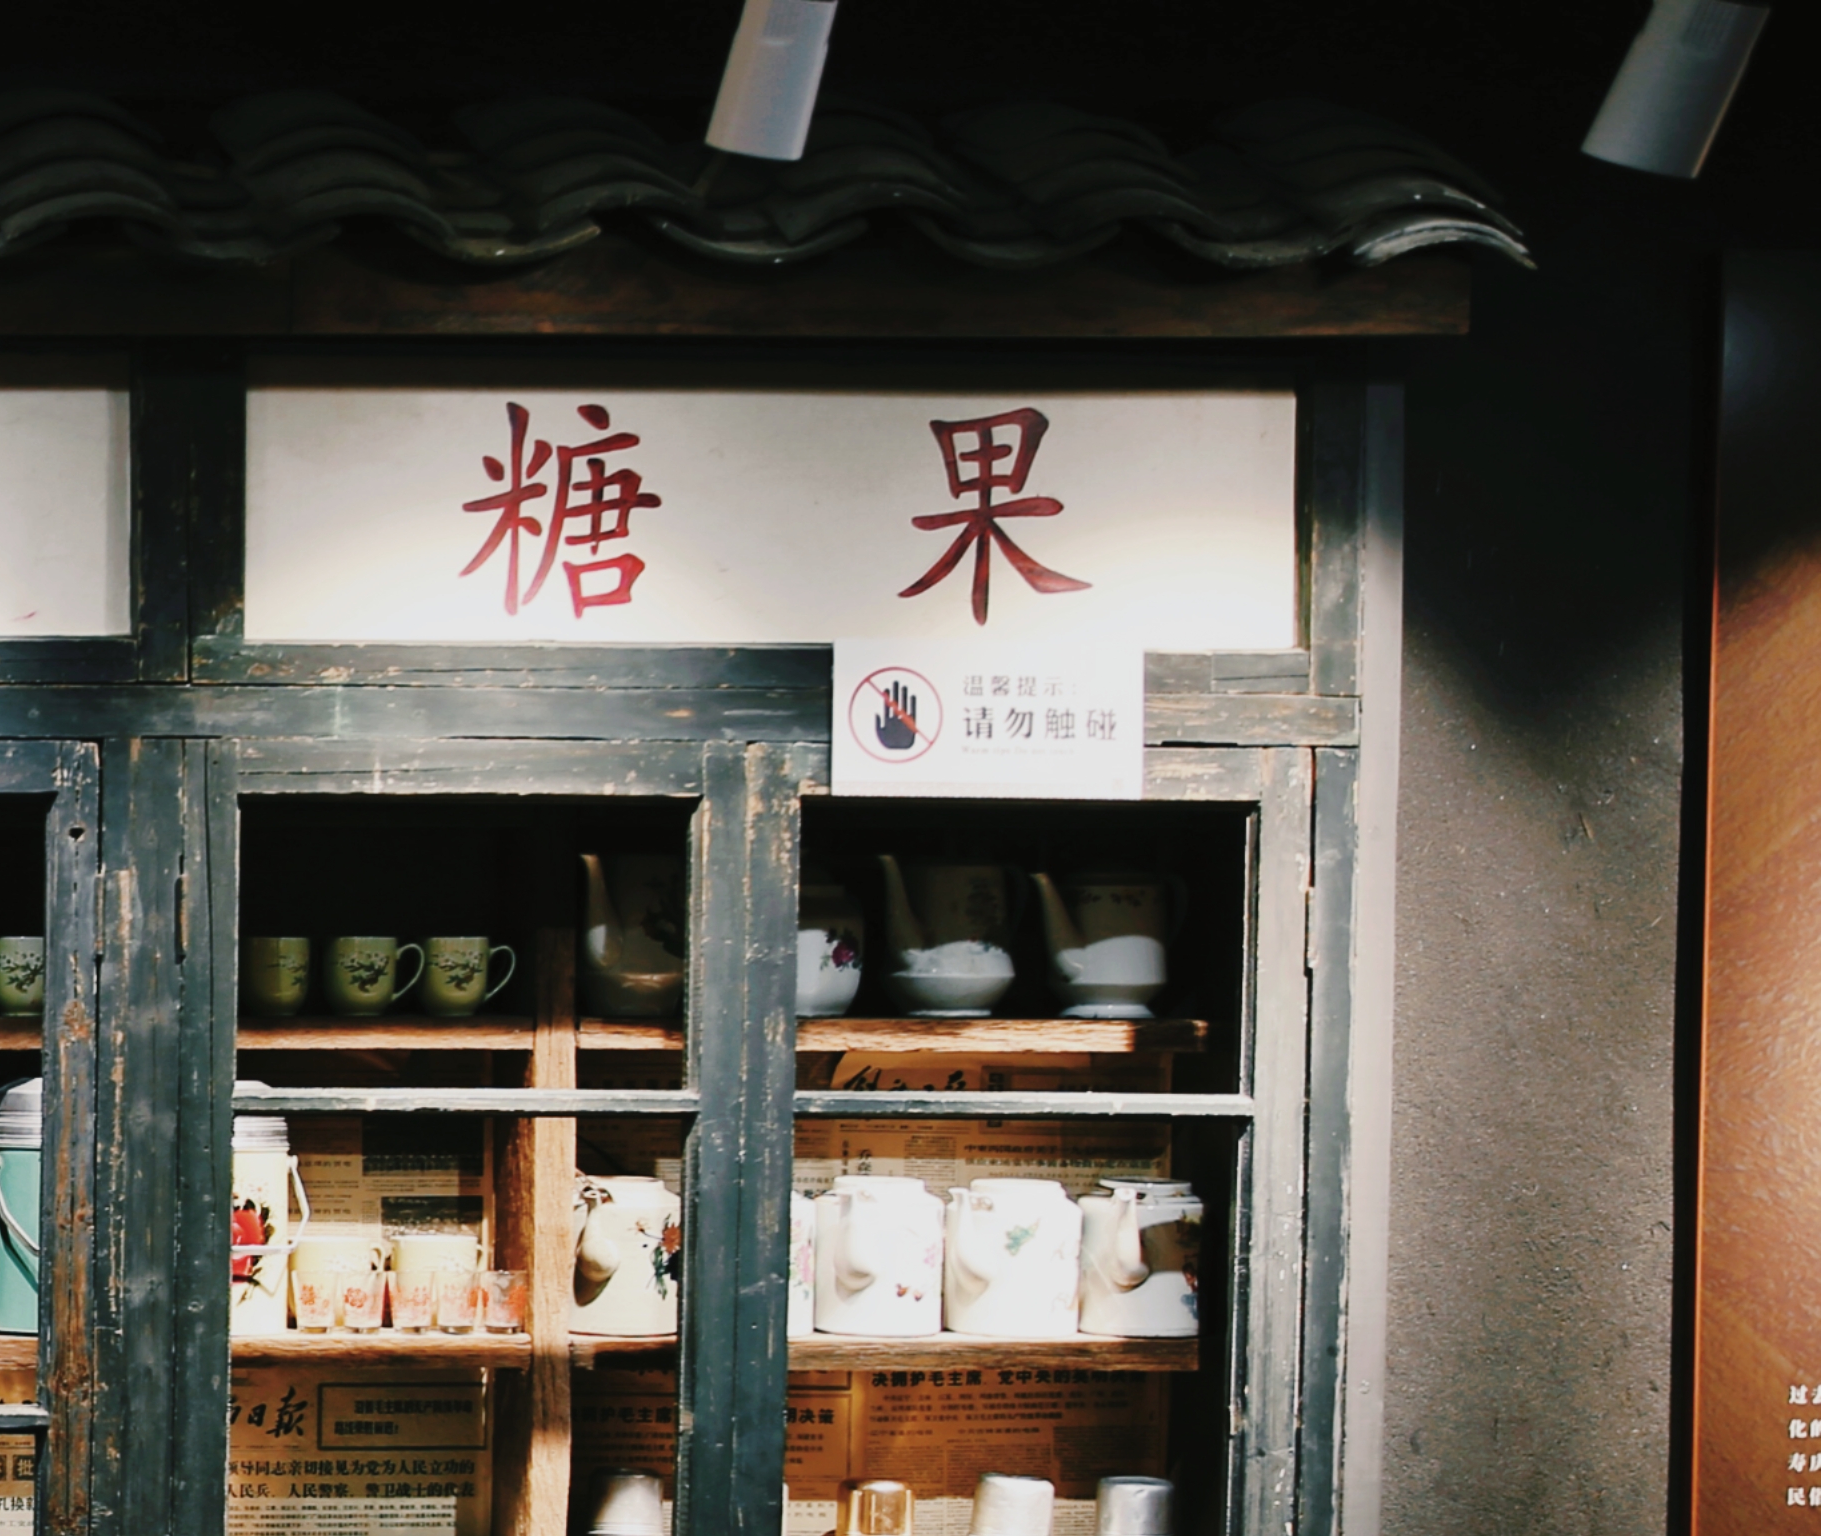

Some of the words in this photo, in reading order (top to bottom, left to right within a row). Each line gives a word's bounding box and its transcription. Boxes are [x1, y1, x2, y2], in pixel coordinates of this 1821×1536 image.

[459, 401, 1093, 625] 糖果
[962, 706, 1118, 742] 请勿触碰
[228, 1386, 309, 1438] 日报
